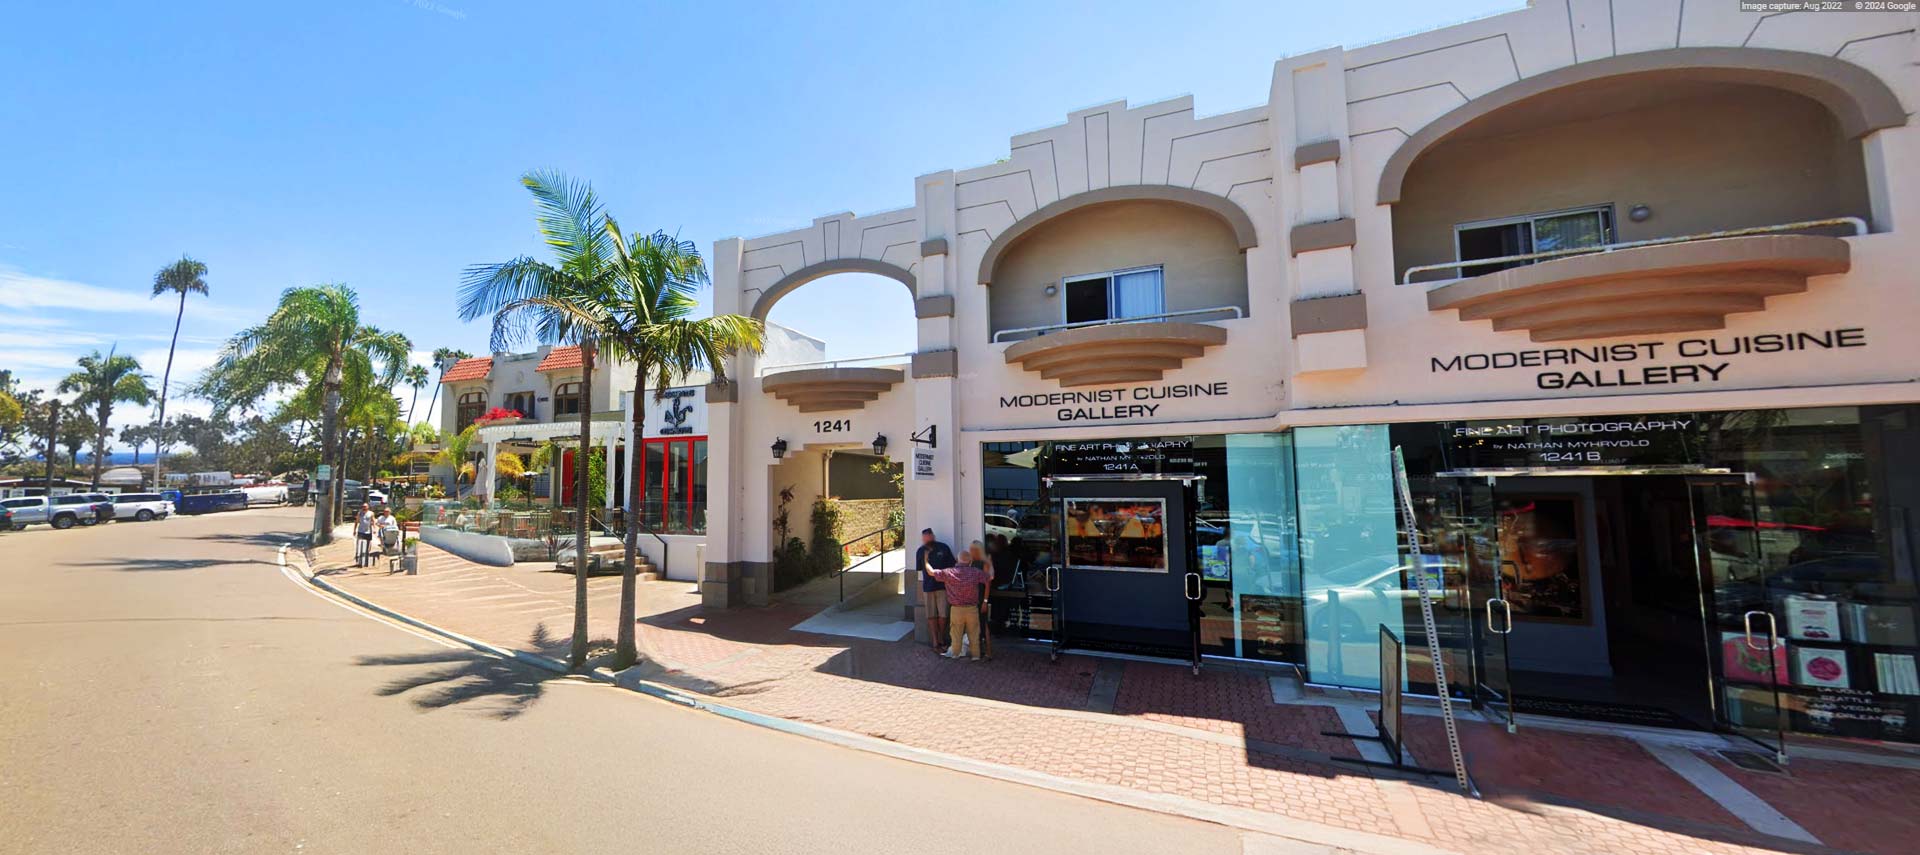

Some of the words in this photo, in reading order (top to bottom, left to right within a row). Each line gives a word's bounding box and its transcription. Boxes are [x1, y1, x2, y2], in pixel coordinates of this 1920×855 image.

[1431, 342, 1664, 373] MODERNIST
[1678, 328, 1867, 357] CUISINE
[1537, 362, 1730, 390] GALLERY
[1000, 388, 1127, 408] MODERNIST
[1133, 381, 1229, 400] CUISINE
[1057, 404, 1160, 421] GALLERY
[813, 419, 851, 433] 1241
[1455, 426, 1493, 437] FINE
[1495, 425, 1533, 436] ART
[1537, 420, 1692, 435] PHOTOGRAPHY
[1079, 443, 1101, 451] ART
[1507, 442, 1563, 450] NATHAN
[1567, 439, 1650, 449] MYHRVOLD
[1540, 453, 1583, 462] 1241
[1586, 451, 1601, 461] B
[1820, 695, 1870, 704] SEATTLE
[1841, 705, 1881, 713] VEGAS
